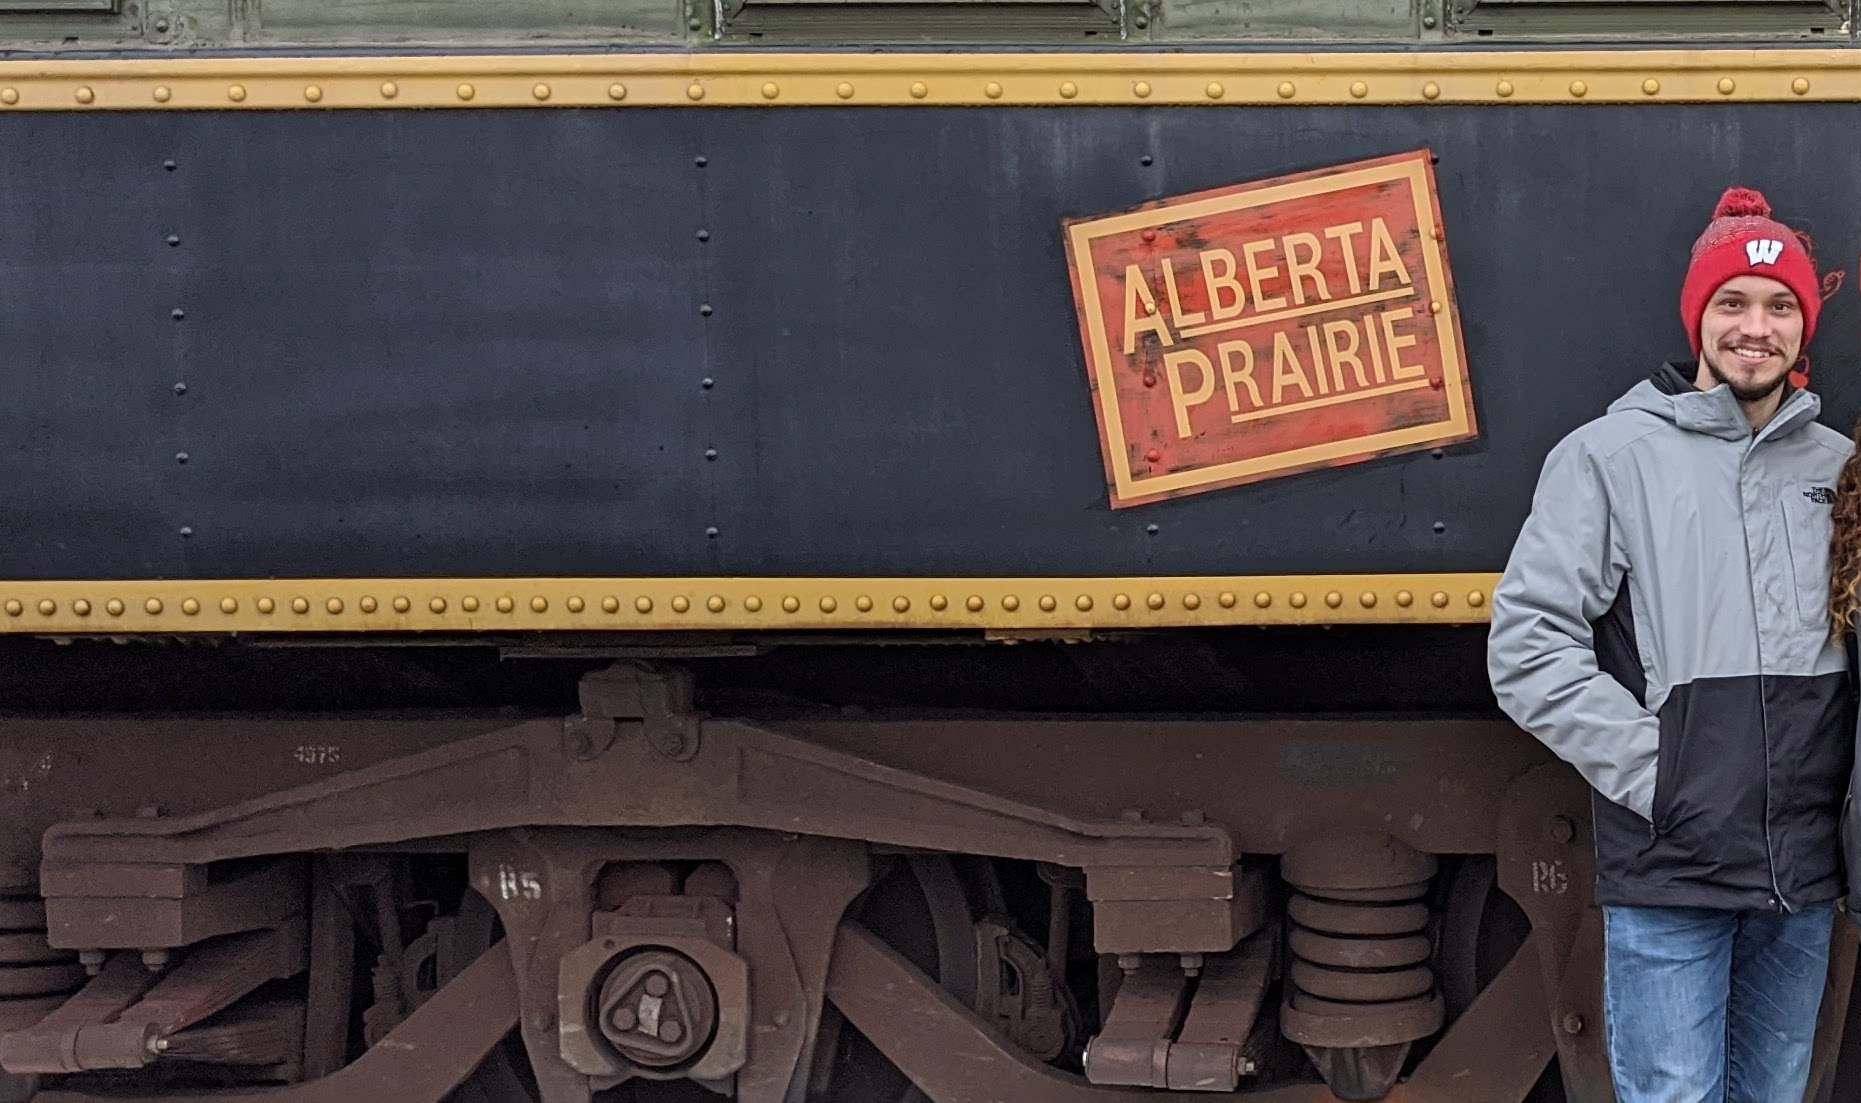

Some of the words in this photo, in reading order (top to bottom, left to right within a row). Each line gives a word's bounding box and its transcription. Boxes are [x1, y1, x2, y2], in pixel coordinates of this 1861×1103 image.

[1123, 217, 1412, 355] ALBERTA
[1745, 238, 1784, 267] W
[1163, 307, 1426, 438] PRAIRIE
